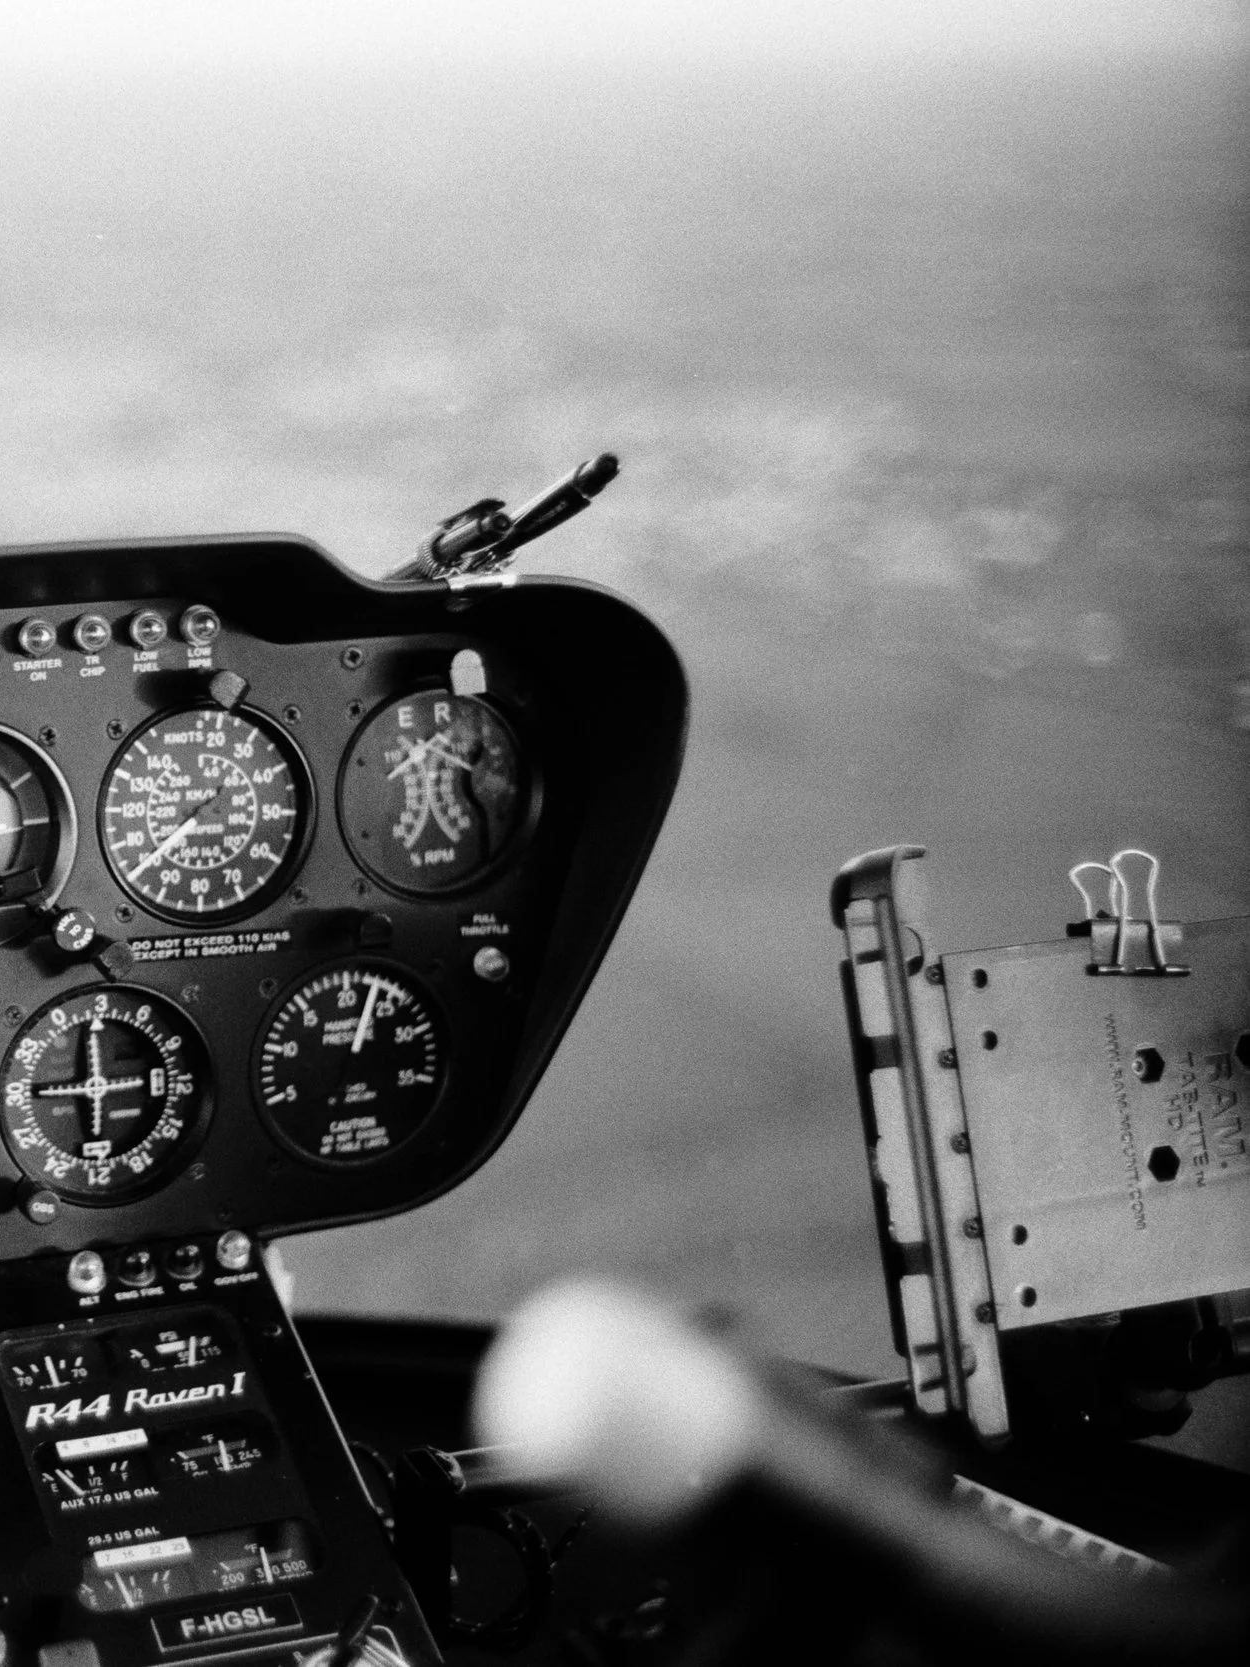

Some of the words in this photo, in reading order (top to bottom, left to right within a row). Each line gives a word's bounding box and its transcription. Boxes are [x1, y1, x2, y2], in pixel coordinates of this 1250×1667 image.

[84, 655, 100, 665] TR
[133, 651, 159, 662] LOW
[13, 658, 62, 672] STARTER
[79, 666, 106, 678] CHIP
[132, 662, 161, 673] FUEL
[29, 671, 47, 682] ON
[397, 705, 414, 728] E
[434, 702, 450, 724] R
[164, 731, 204, 744] KNOTS
[206, 732, 225, 748] 20
[233, 743, 253, 758] 30
[147, 754, 172, 770] 140
[253, 768, 273, 783] 40
[130, 777, 154, 792] 130
[123, 802, 145, 818] 120
[262, 804, 281, 821] 50
[126, 831, 144, 847] 110
[250, 843, 270, 858] 60
[160, 869, 180, 884] 90
[222, 869, 242, 884] 70
[190, 878, 210, 894] 80
[131, 941, 151, 952] DO
[154, 938, 180, 949] NOT
[184, 935, 234, 948] EXCEED
[262, 931, 290, 942] KIAS
[133, 948, 181, 962] EXCEPT
[184, 947, 198, 957] IN
[202, 944, 253, 957] SMOOTH
[94, 994, 108, 1013] 3
[337, 989, 357, 1009] 20
[50, 1008, 67, 1026] 0
[136, 1005, 151, 1023] 6
[394, 1025, 414, 1044] 30
[14, 1037, 39, 1064] 33
[165, 1035, 182, 1051] 9
[176, 1072, 194, 1095] 12
[5, 1081, 24, 1107] 30
[285, 1084, 298, 1102] 5
[162, 1117, 184, 1140] 15
[12, 1127, 38, 1150] 27
[43, 1156, 70, 1180] 24
[129, 1151, 153, 1174] 18
[88, 1166, 111, 1186] 21
[70, 1367, 88, 1378] 70
[16, 1376, 34, 1387] 70
[25, 1394, 111, 1429] R44
[124, 1384, 225, 1413] Raven
[182, 1460, 198, 1472] 75
[121, 1472, 128, 1482] F
[61, 1498, 86, 1511] AUX
[114, 1491, 131, 1501] US
[133, 1487, 159, 1498] GAL
[114, 1530, 132, 1541] US
[134, 1526, 160, 1537] GAL
[255, 1564, 280, 1578] 30
[282, 1560, 308, 1573] 500
[221, 1572, 245, 1586] 200
[180, 1606, 276, 1639] F-HGSL
